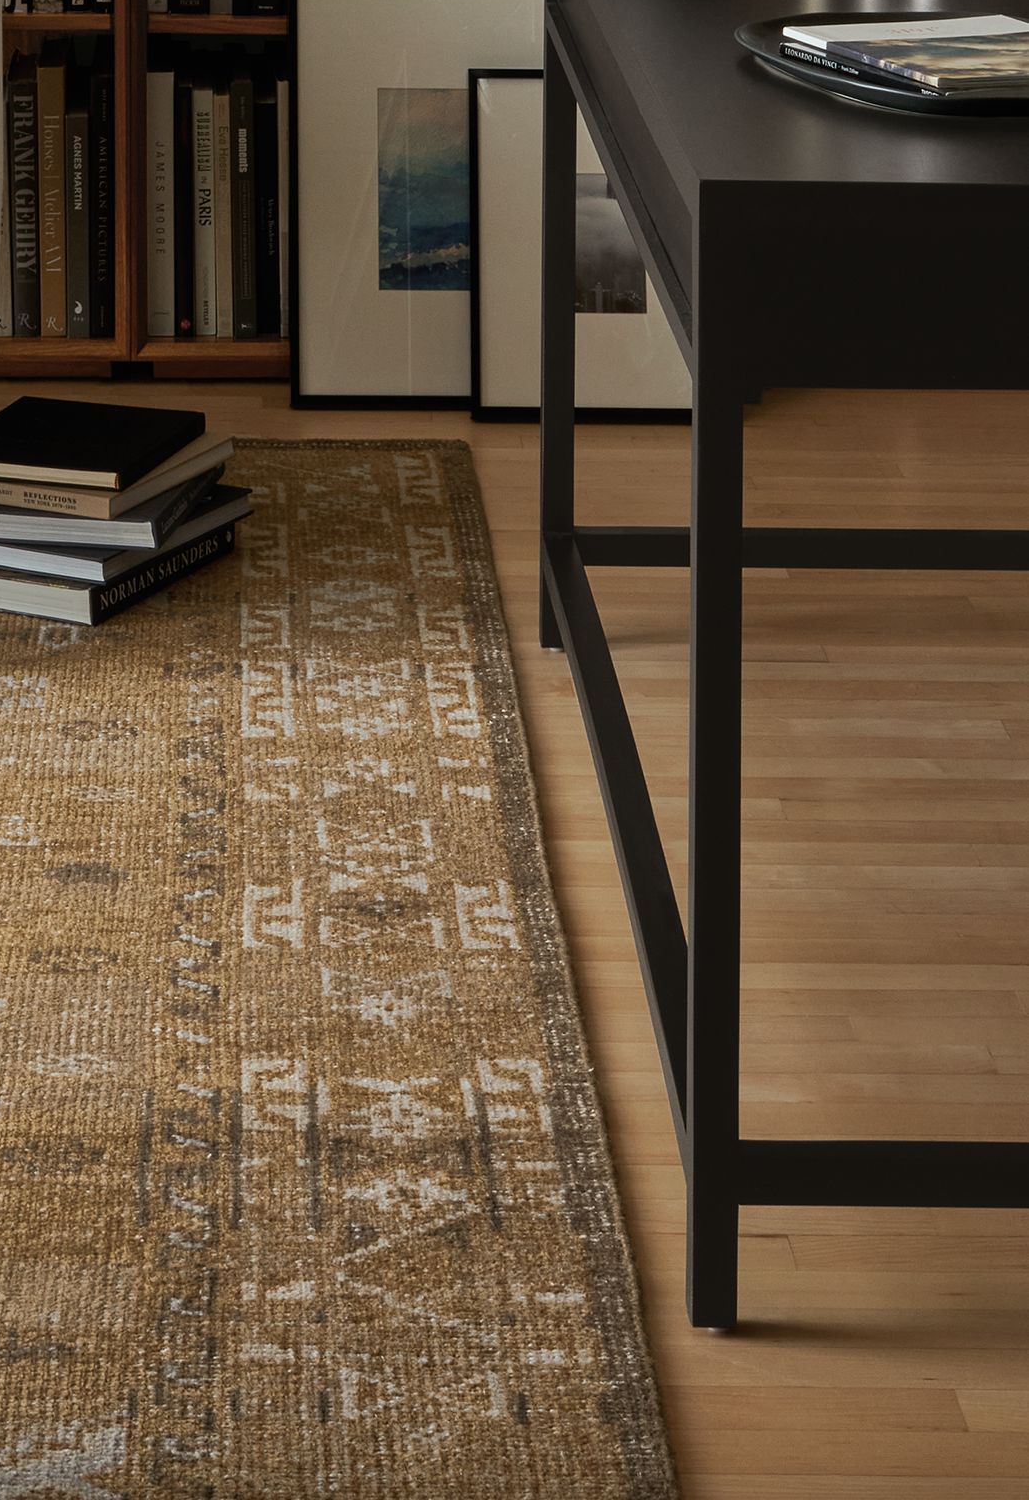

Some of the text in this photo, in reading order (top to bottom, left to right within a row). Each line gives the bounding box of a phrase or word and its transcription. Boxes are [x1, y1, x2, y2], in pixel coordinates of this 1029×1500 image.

[785, 47, 837, 69] LEONARDO DA VINCI
[13, 95, 37, 274] FRANK GEHRY
[99, 538, 219, 611] NORMAN SAUNDERS
